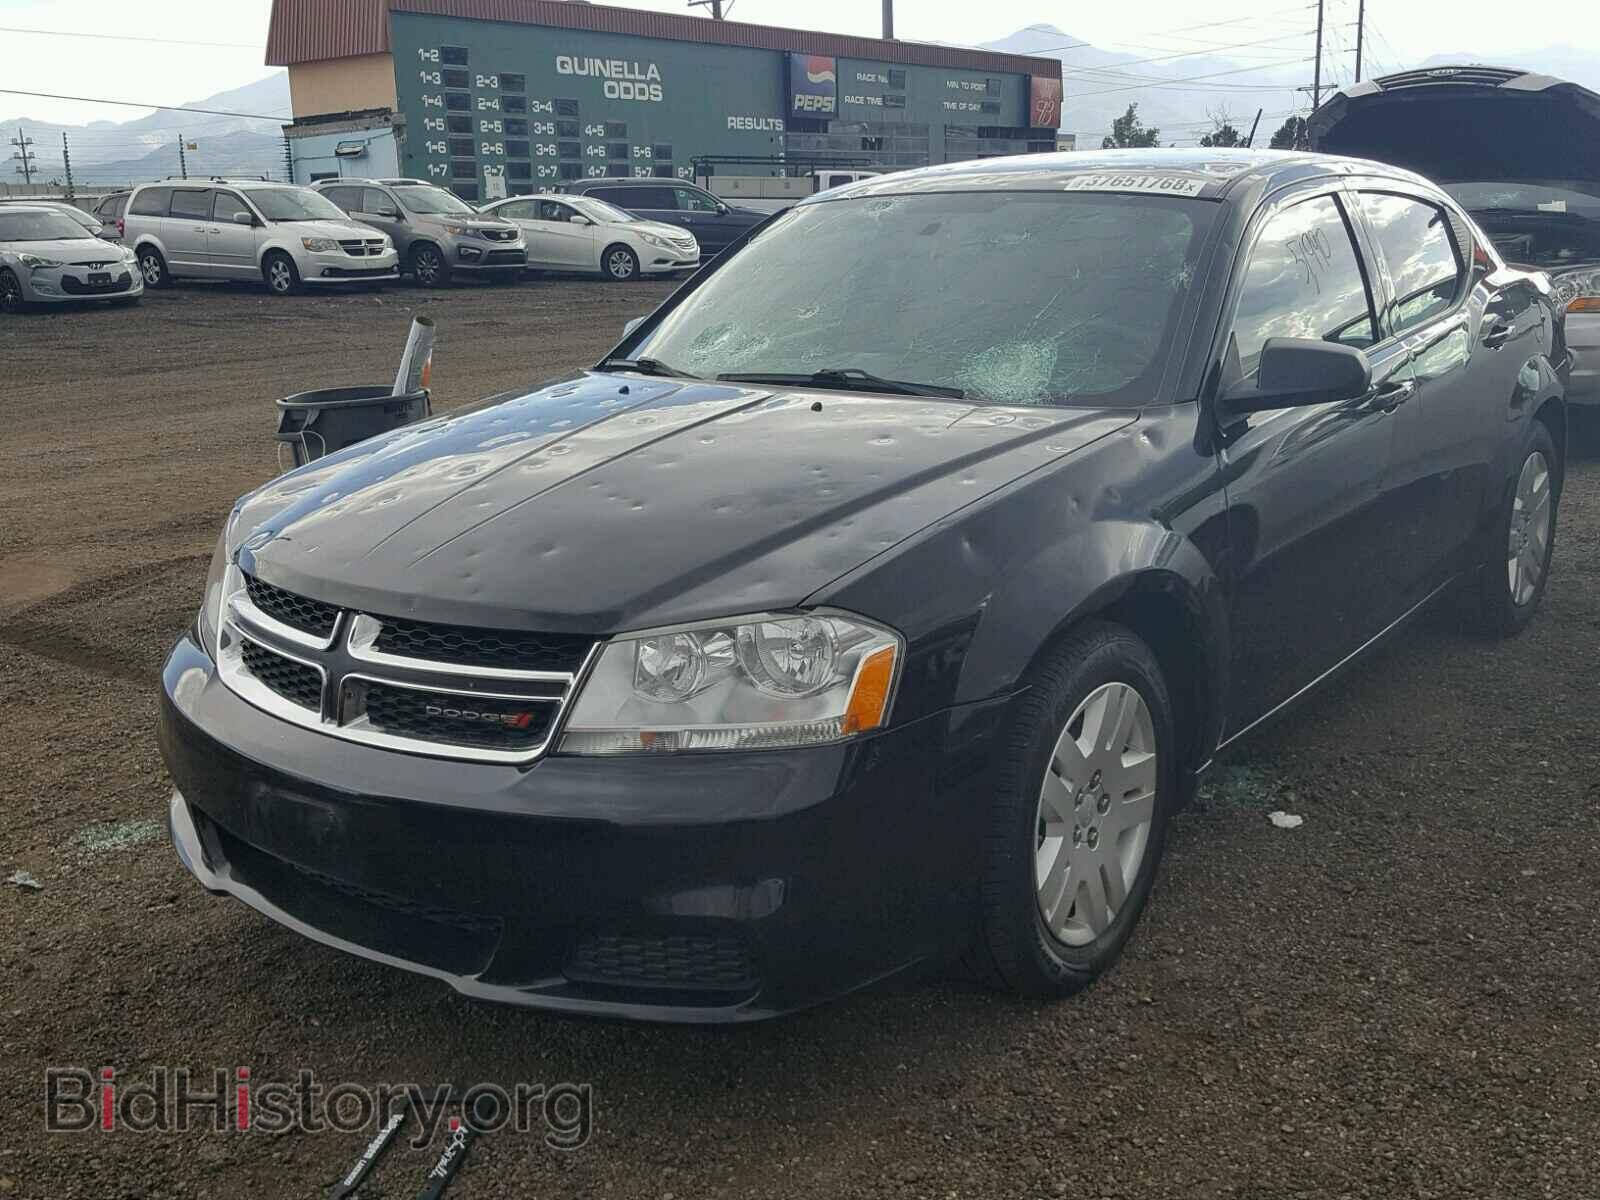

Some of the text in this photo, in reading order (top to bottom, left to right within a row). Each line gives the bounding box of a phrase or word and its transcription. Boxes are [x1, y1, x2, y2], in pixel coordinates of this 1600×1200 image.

[556, 55, 662, 82] QUINELLA
[856, 72, 876, 82] RACE
[604, 81, 663, 102] ODDS
[844, 95, 883, 105] RACE TIME
[794, 94, 836, 113] PEPSI
[728, 116, 784, 131] RESULTS
[426, 705, 519, 727] DODGE
